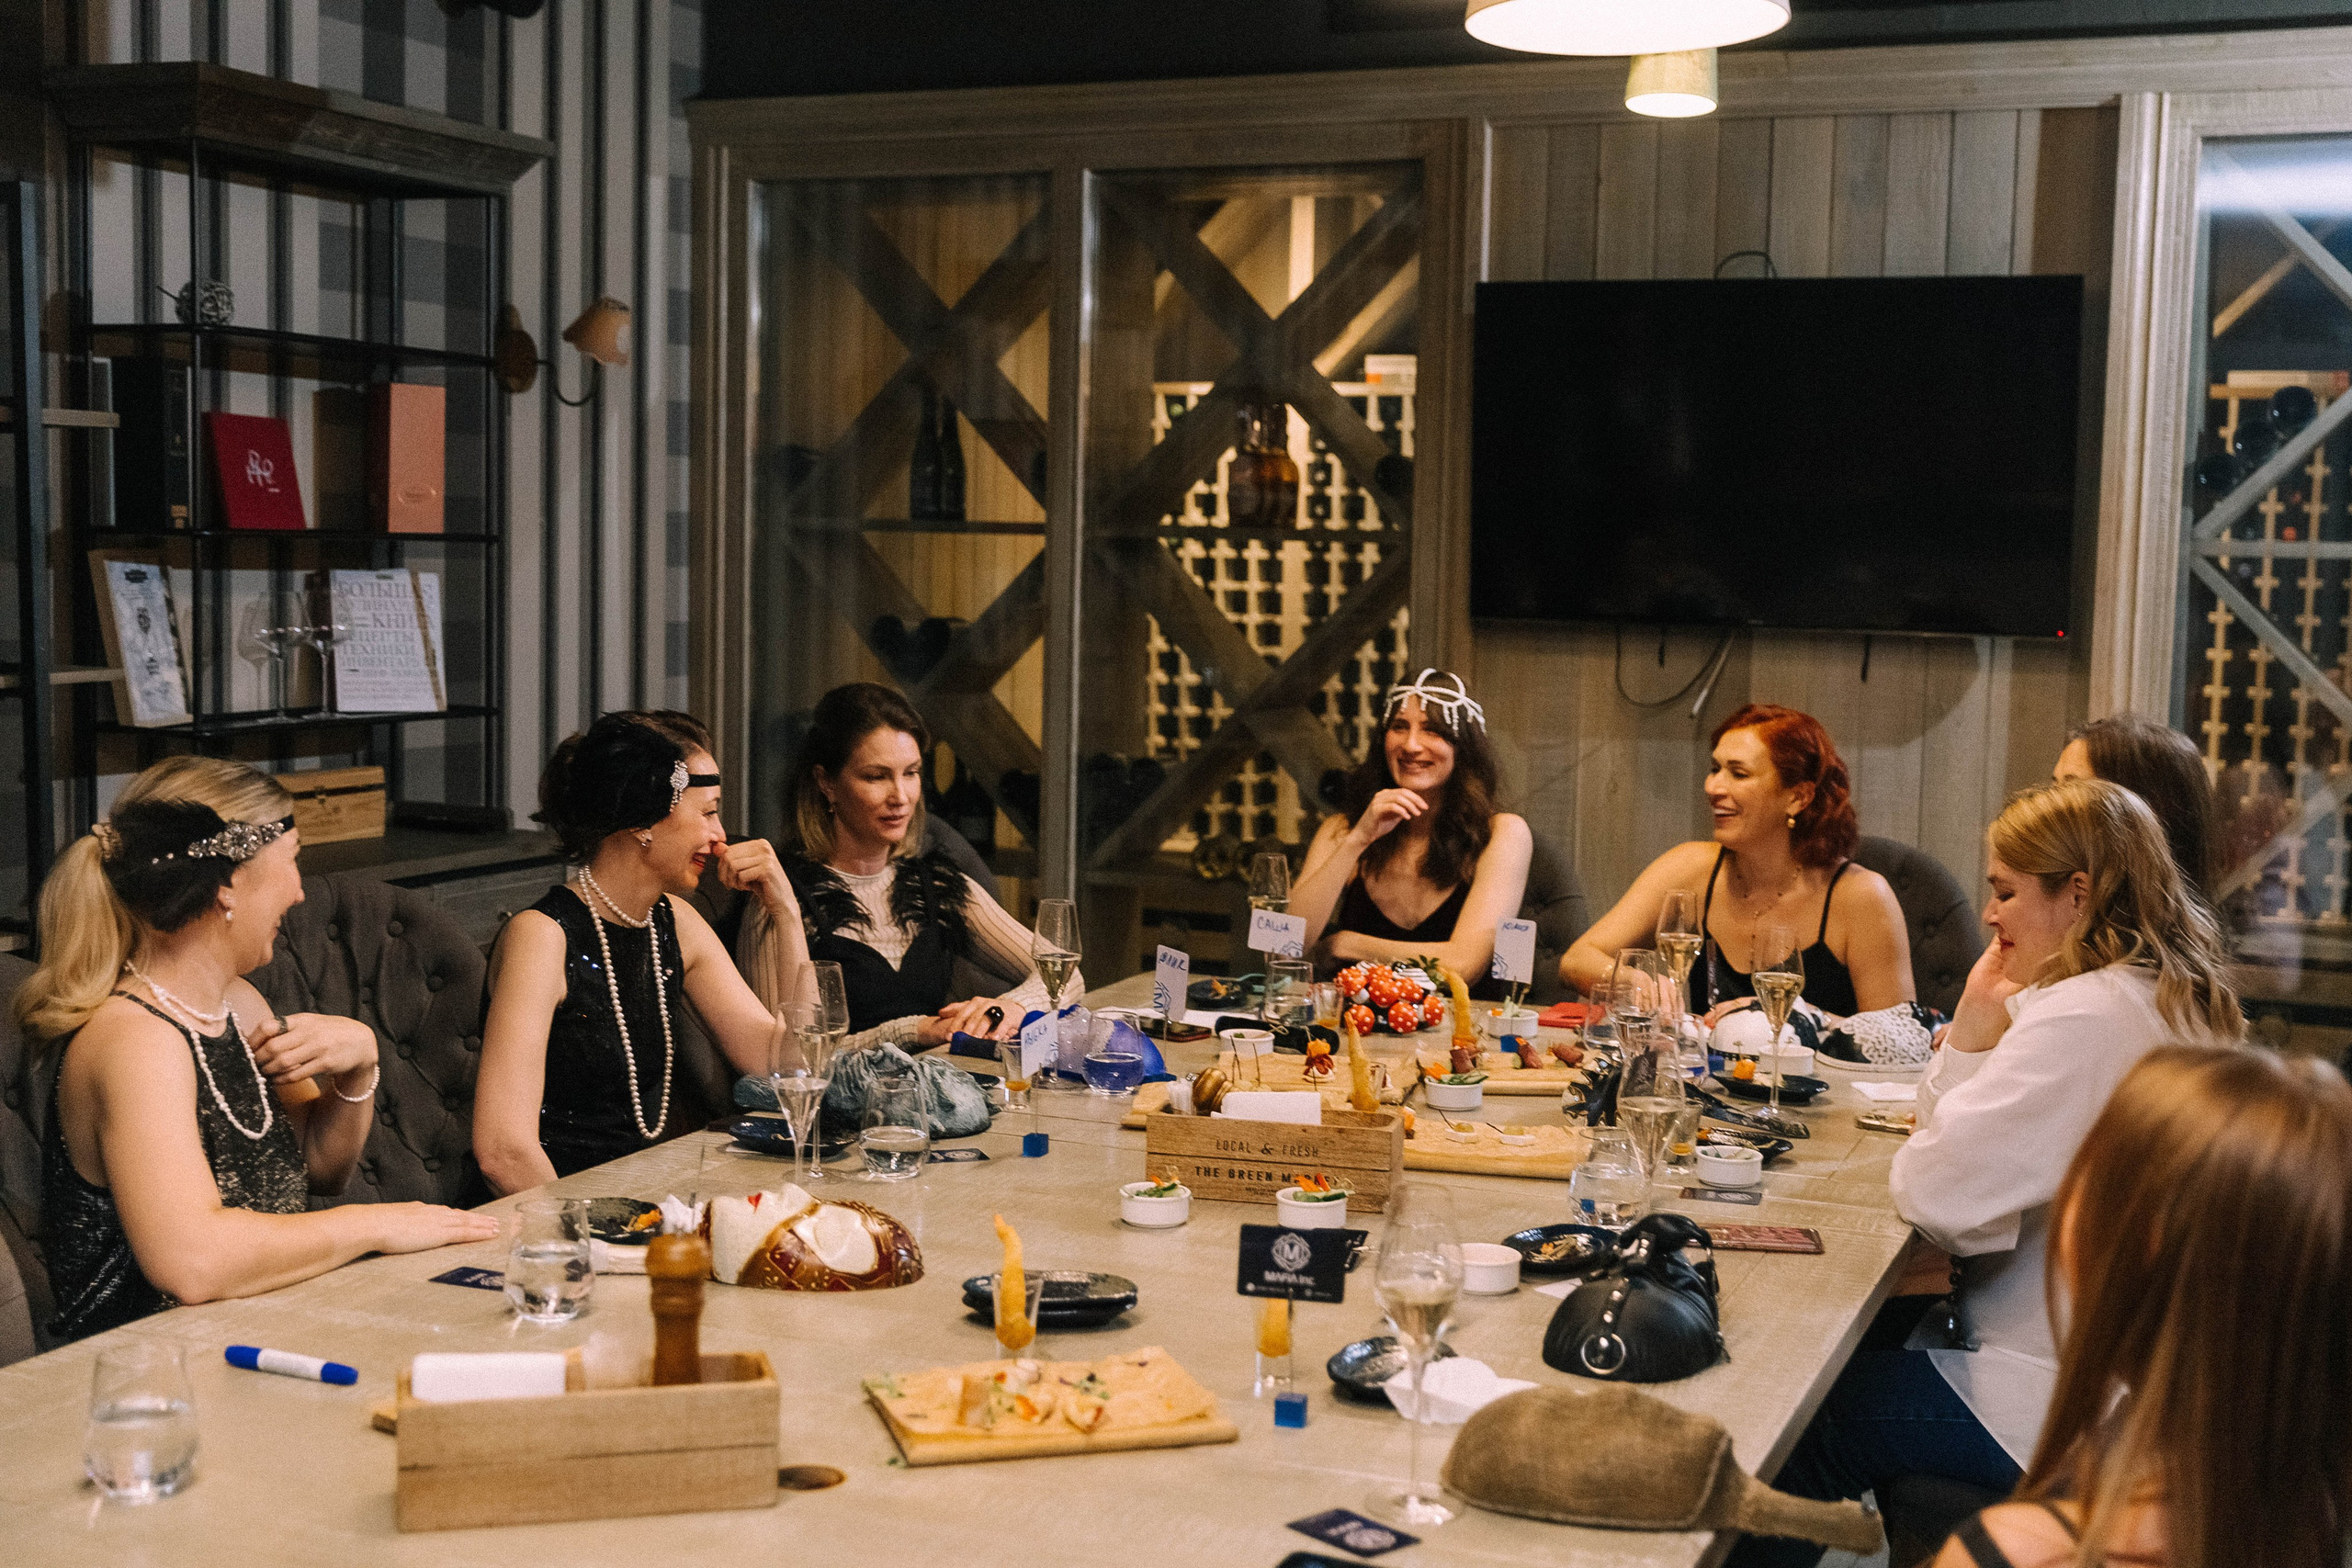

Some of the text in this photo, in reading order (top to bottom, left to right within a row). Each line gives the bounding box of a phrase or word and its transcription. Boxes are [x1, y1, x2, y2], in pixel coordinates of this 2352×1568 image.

[1216, 1139, 1319, 1157] LOCAL & FRESH
[1195, 1166, 1220, 1178] THE
[1228, 1168, 1273, 1182] GREEN
